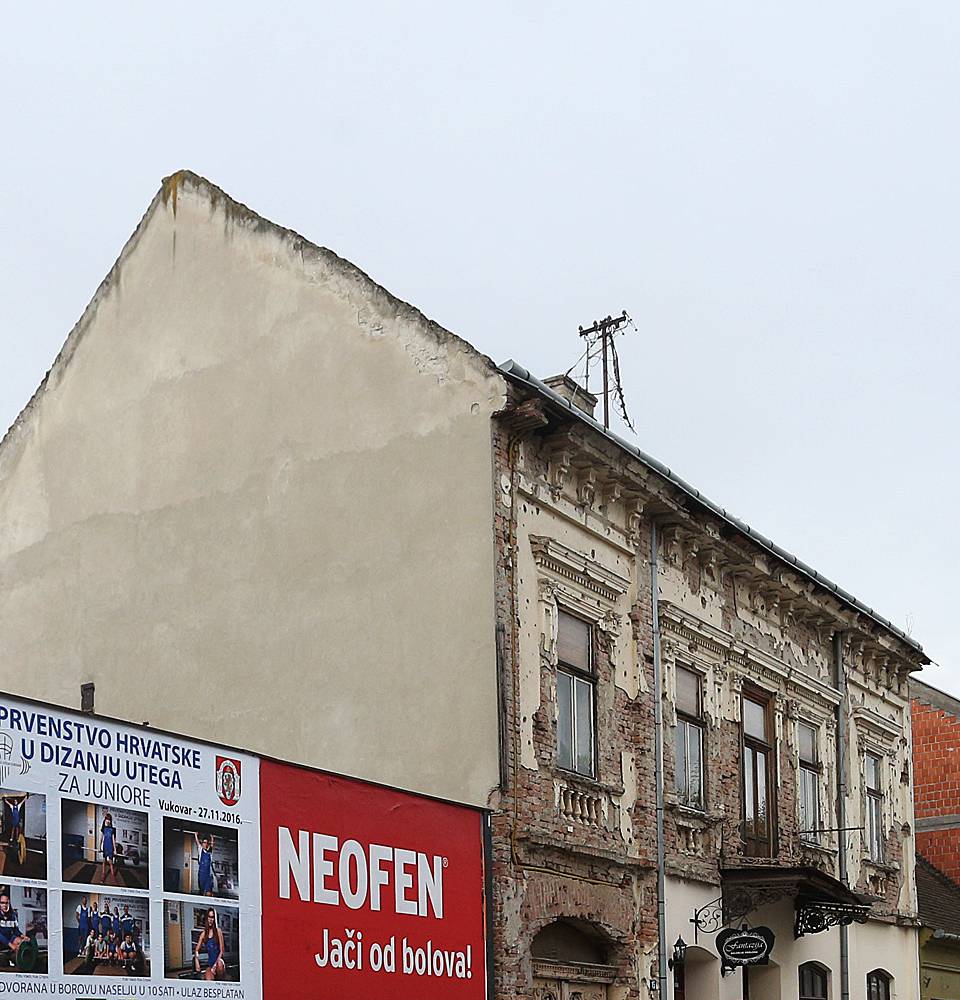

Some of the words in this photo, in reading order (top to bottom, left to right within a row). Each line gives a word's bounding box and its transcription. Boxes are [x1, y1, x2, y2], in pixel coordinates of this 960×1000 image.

[0, 705, 112, 749] PRVENSTVO
[116, 732, 201, 769] HRVATSKE
[21, 738, 34, 760] U
[41, 742, 120, 776] DIZANJU
[126, 759, 182, 790] UTEGA
[58, 772, 80, 795] ZA
[85, 778, 150, 807] JUNIORE
[158, 798, 192, 816] Vukovar
[198, 807, 243, 825] 27.11.2016.
[278, 825, 444, 919] NEOFEN
[314, 928, 363, 970] Jači
[369, 935, 396, 973] od
[402, 937, 472, 979] bolova!
[50, 983, 56, 994] U
[59, 983, 96, 995] BOROVU
[99, 984, 137, 996] NASELJU
[139, 985, 145, 996] U
[181, 987, 202, 998] ULAZ
[203, 988, 245, 999] BESPLATAN
